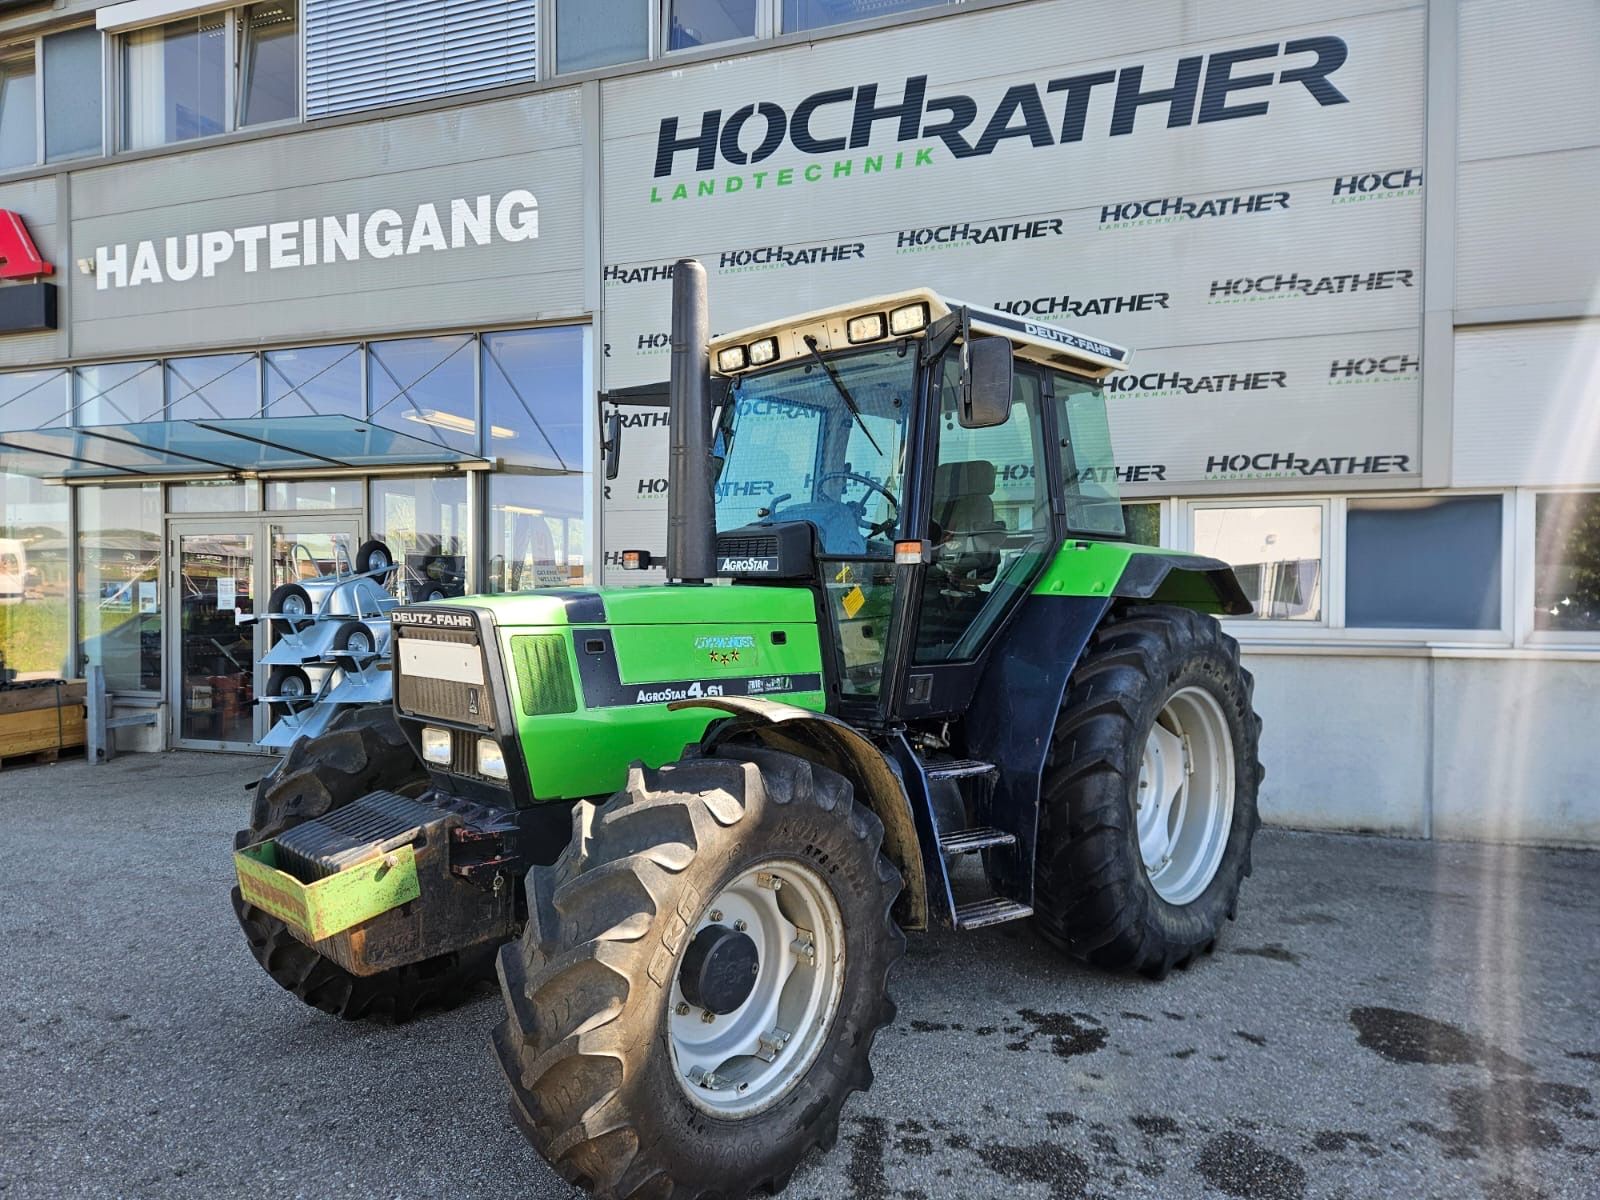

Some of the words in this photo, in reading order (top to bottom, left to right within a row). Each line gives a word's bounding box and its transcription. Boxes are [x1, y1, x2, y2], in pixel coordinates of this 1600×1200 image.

[654, 36, 1349, 177] HOCHRATHER
[650, 149, 935, 203] LANDTECHNIK
[1100, 192, 1290, 223] HOCHRATHER
[897, 219, 1063, 248] HOCHRATHER
[1098, 215, 1186, 231] LANDTECHNIK
[95, 190, 540, 291] HAUPTEINGANG
[896, 240, 971, 255] LANDTECHNIK
[719, 242, 865, 268] HOCHRATHER
[1209, 269, 1414, 301] HOCHRATHER
[994, 292, 1170, 317] HOCHRATHER
[1101, 371, 1287, 394] HOCHRATHER
[1206, 452, 1409, 476] HOCHRATHER
